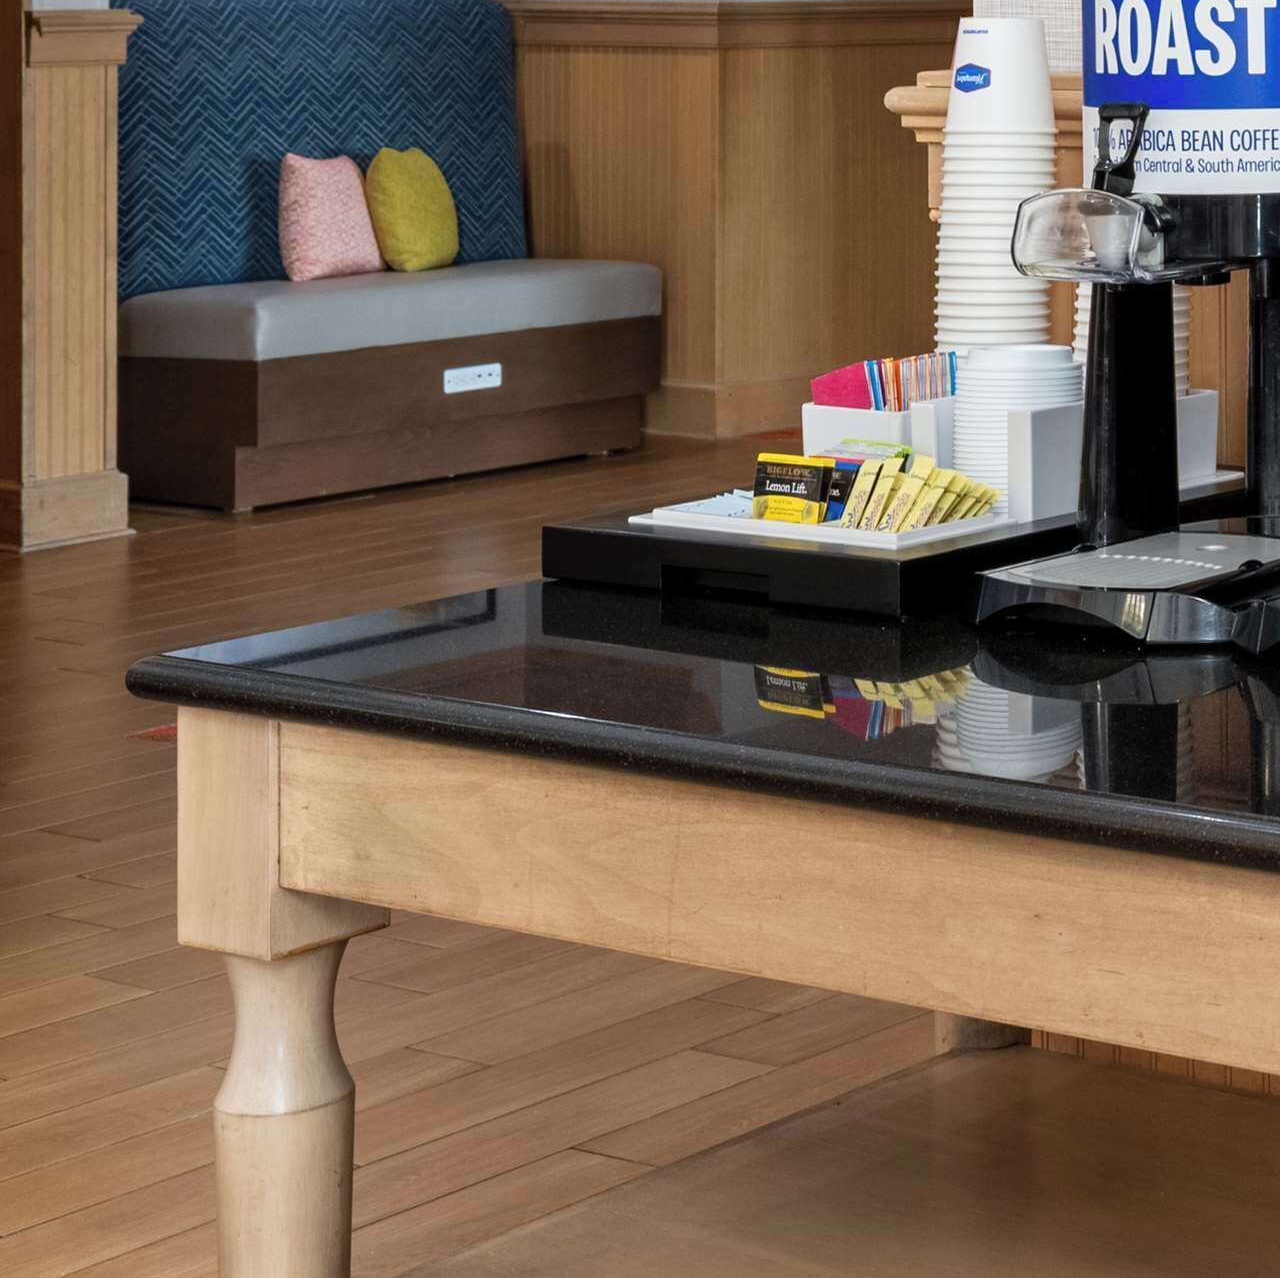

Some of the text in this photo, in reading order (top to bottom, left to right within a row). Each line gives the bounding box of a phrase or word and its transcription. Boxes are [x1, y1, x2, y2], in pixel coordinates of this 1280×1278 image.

[1181, 129, 1224, 152] BEAN
[1143, 158, 1182, 173] Central
[1185, 158, 1195, 173] &
[1197, 157, 1234, 173] South
[767, 465, 810, 477] BIGELOW
[766, 480, 790, 493] Lemon
